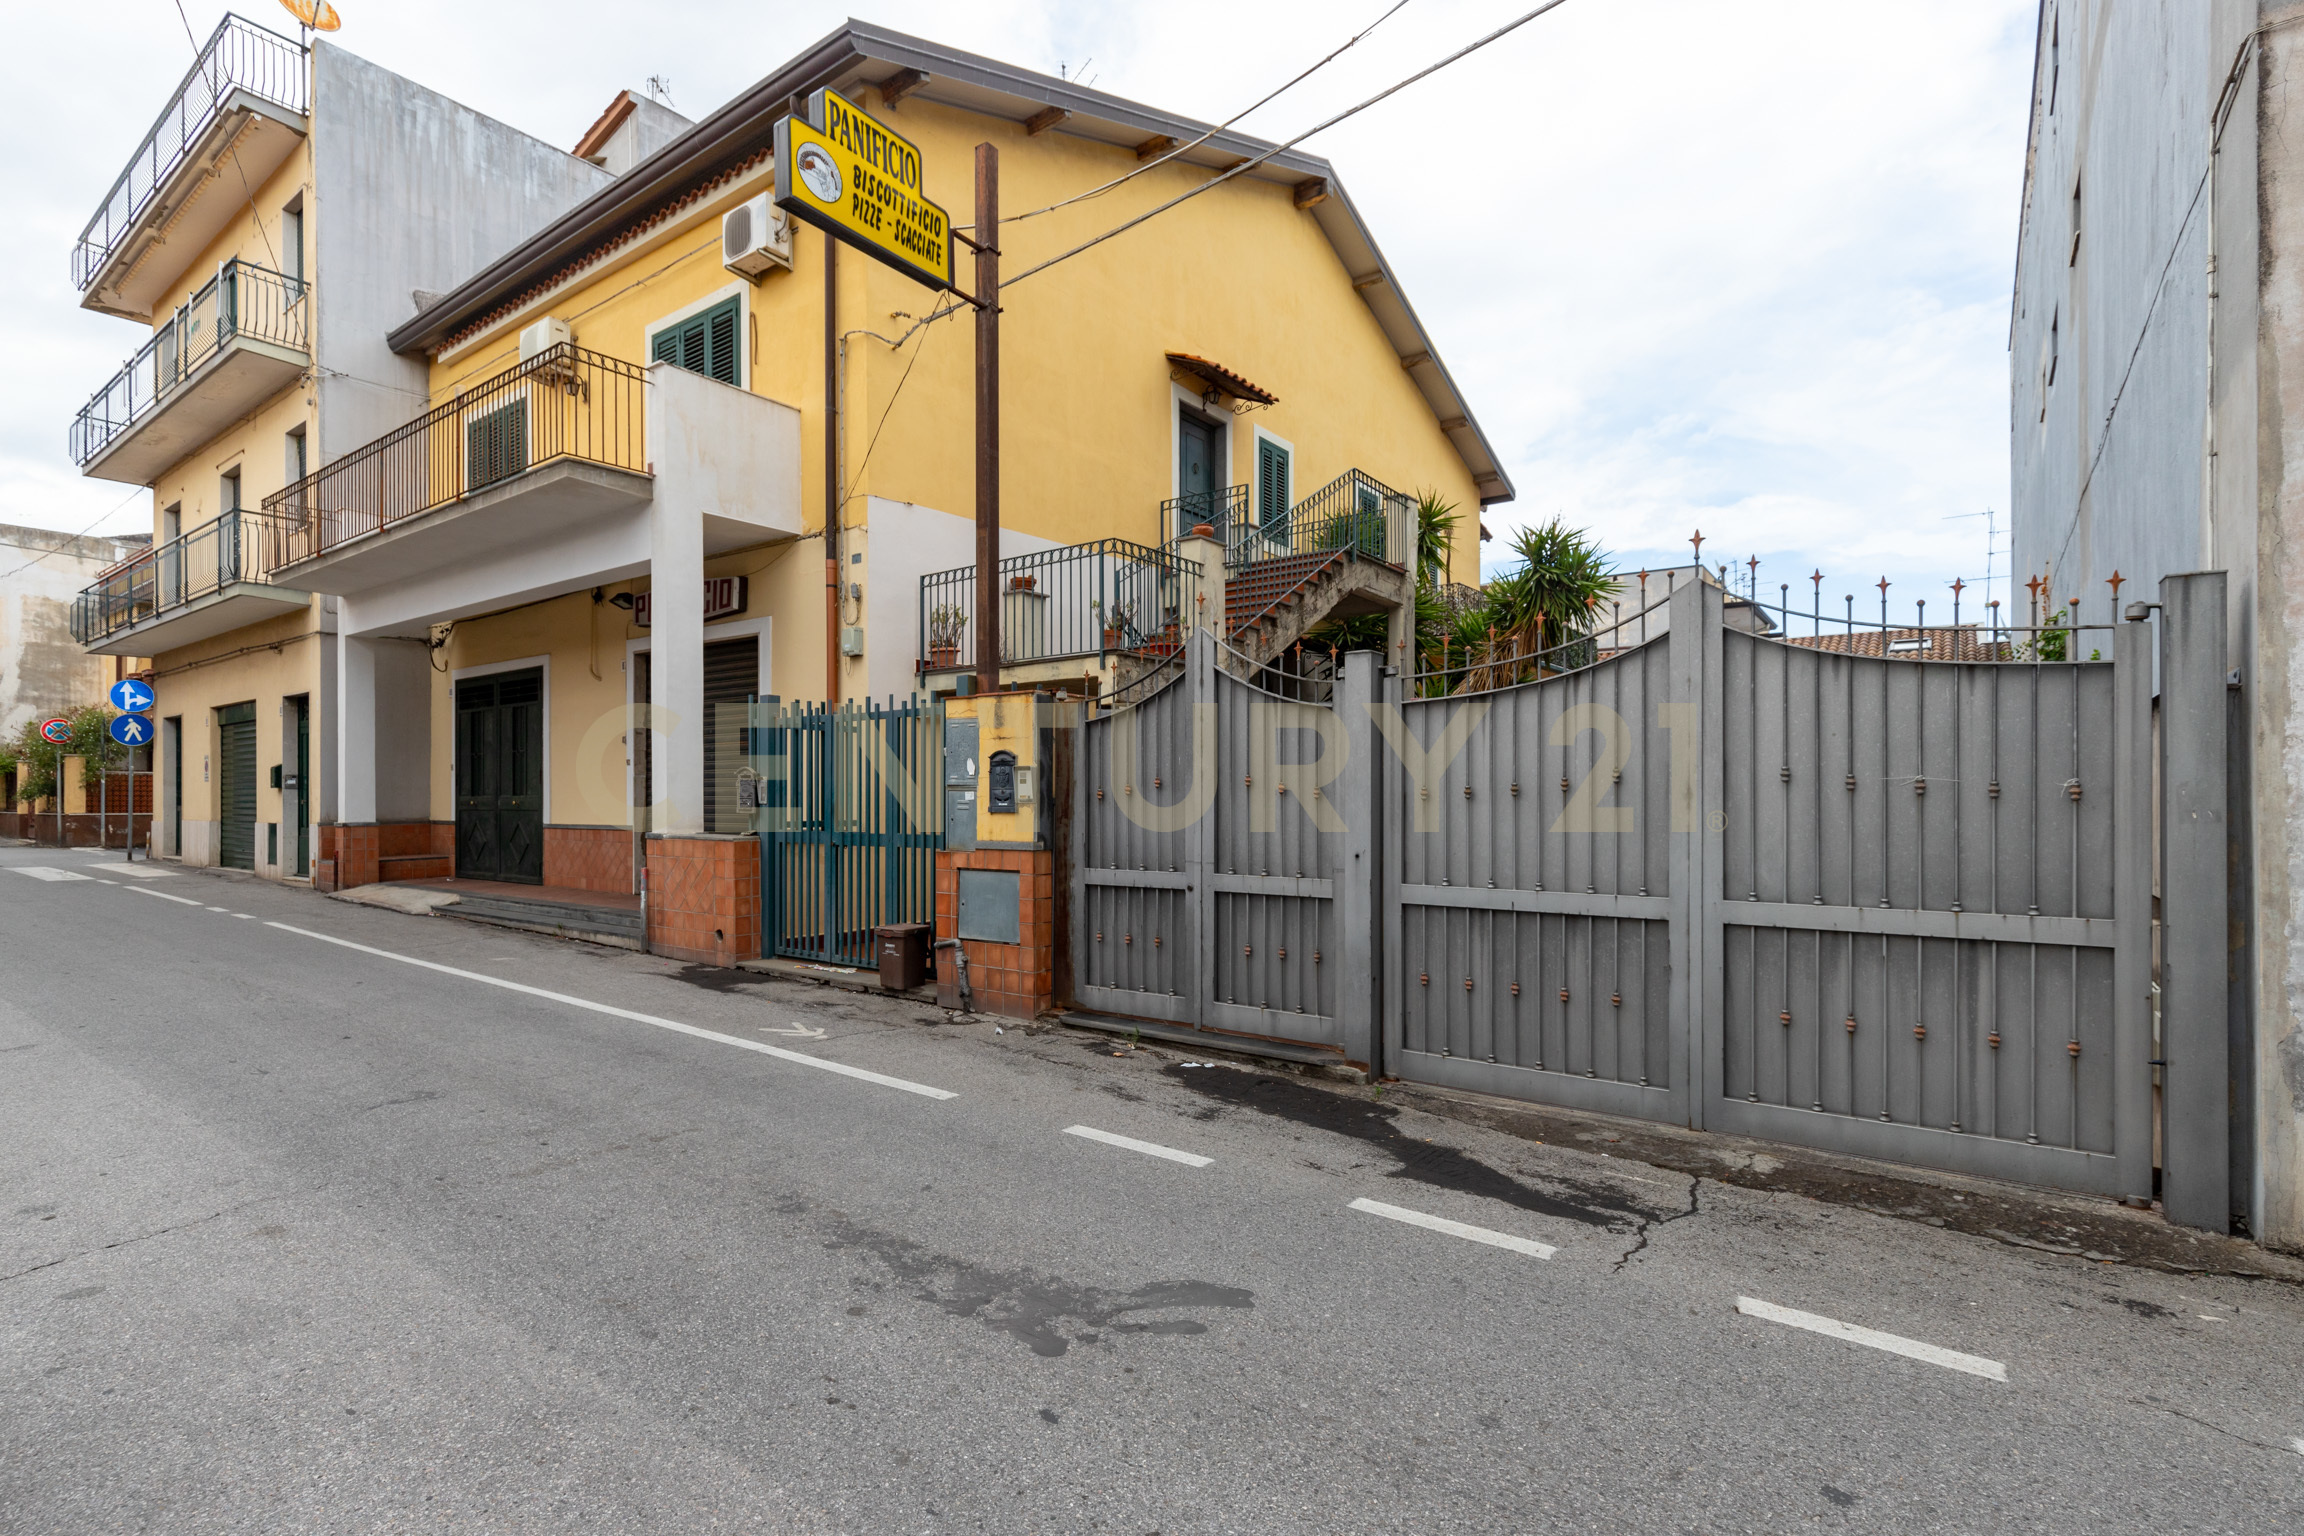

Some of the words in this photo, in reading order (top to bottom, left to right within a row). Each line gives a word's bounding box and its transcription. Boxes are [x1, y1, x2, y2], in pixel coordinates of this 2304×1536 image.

[828, 98, 916, 190] PANIFICIO
[852, 192, 883, 232] PIZZE
[894, 219, 942, 266] SCACCIATE
[853, 165, 941, 239] BISCOTTIFICIO
